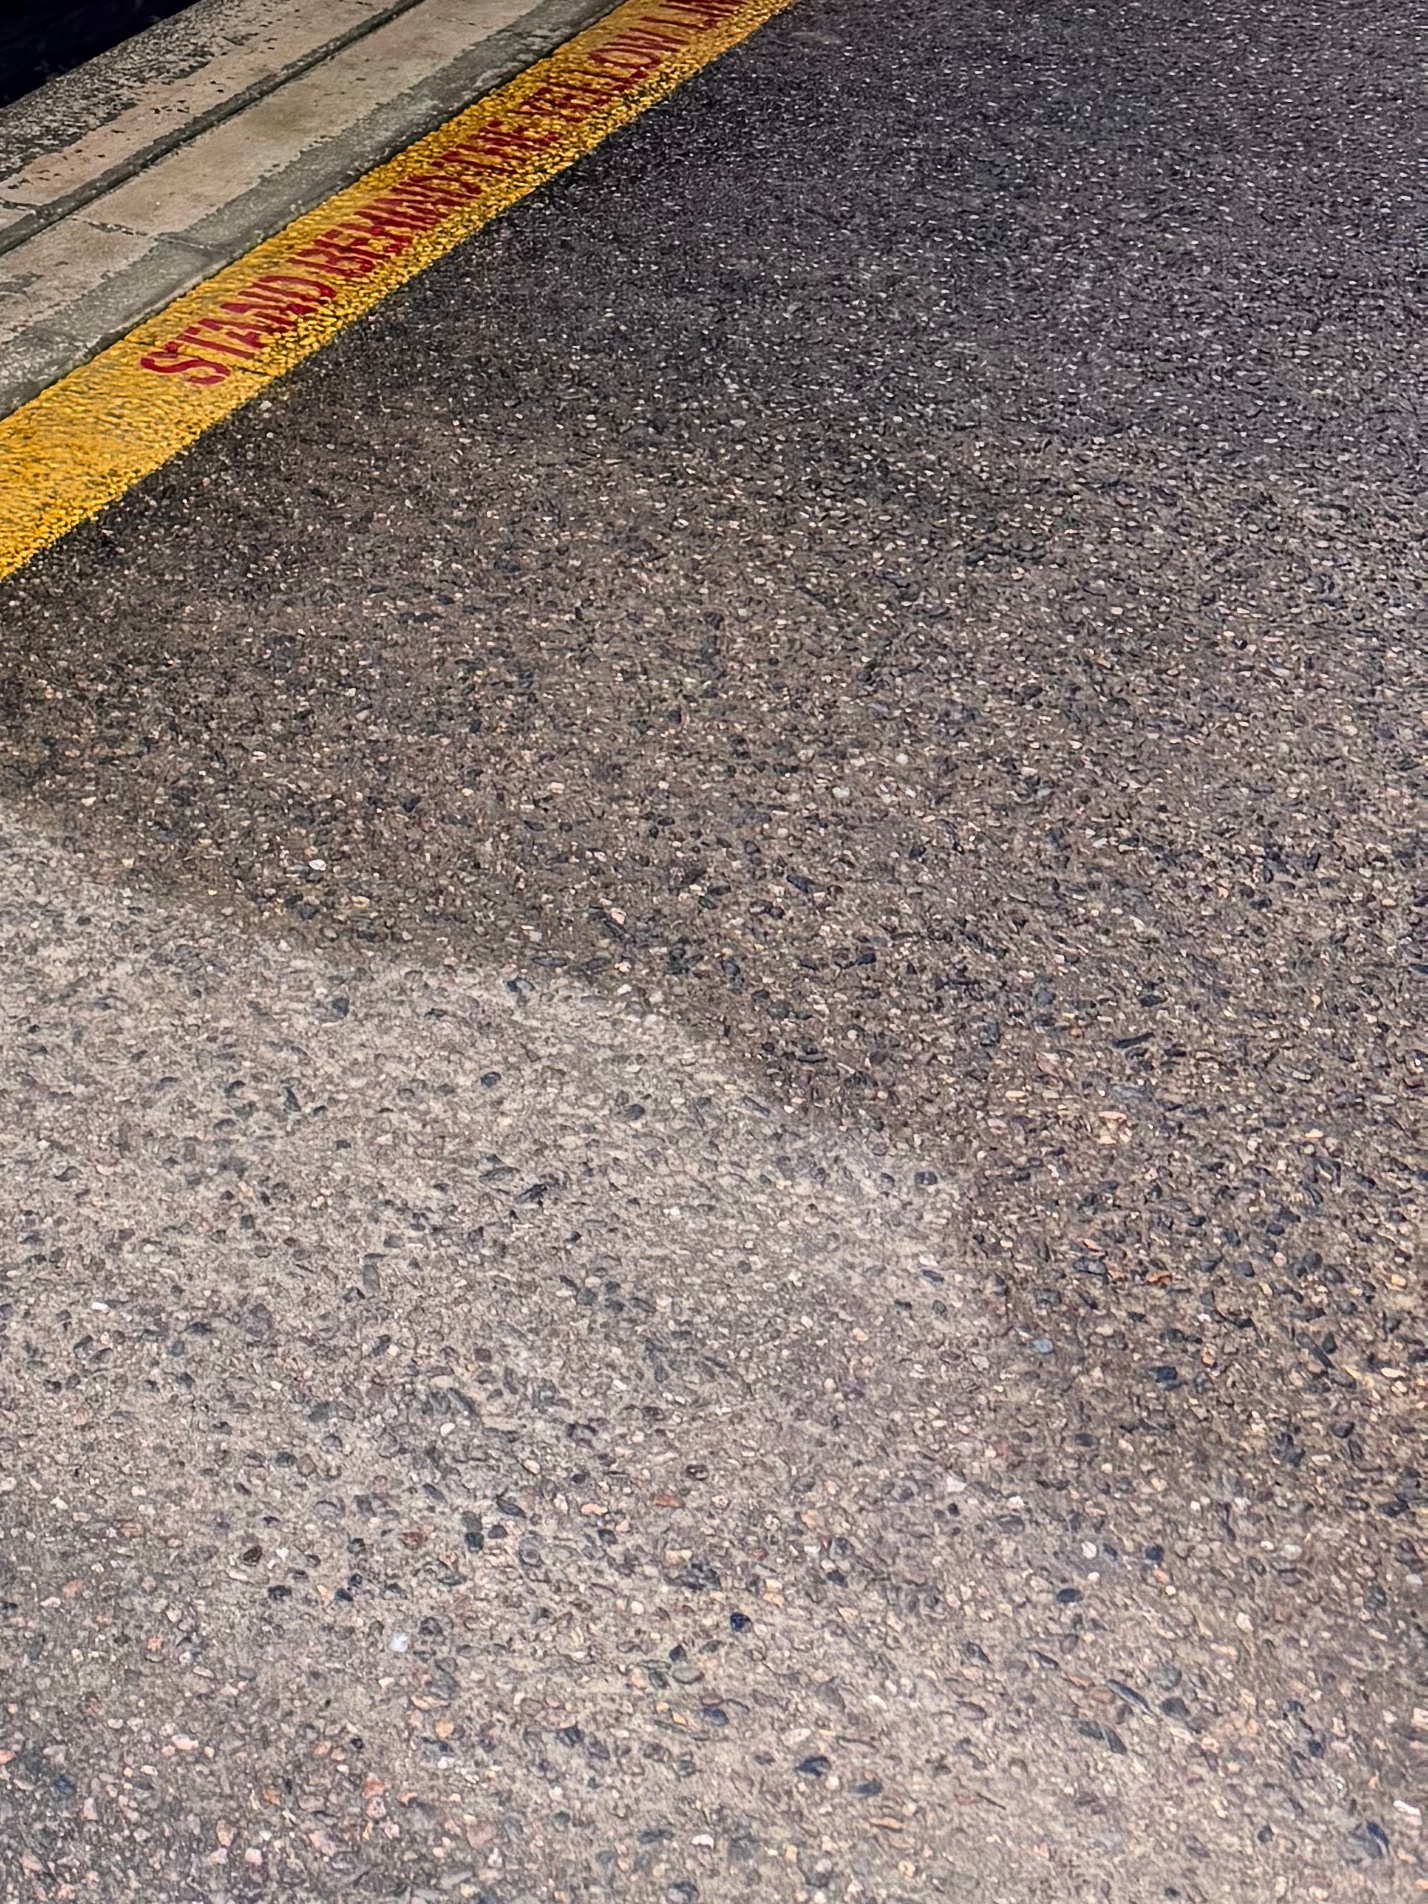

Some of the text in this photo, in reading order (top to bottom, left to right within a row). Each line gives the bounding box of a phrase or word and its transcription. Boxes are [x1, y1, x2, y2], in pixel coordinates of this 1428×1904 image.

[140, 275, 336, 385] STAND
[283, 174, 482, 278] BEHIND
[431, 119, 561, 176] THE
